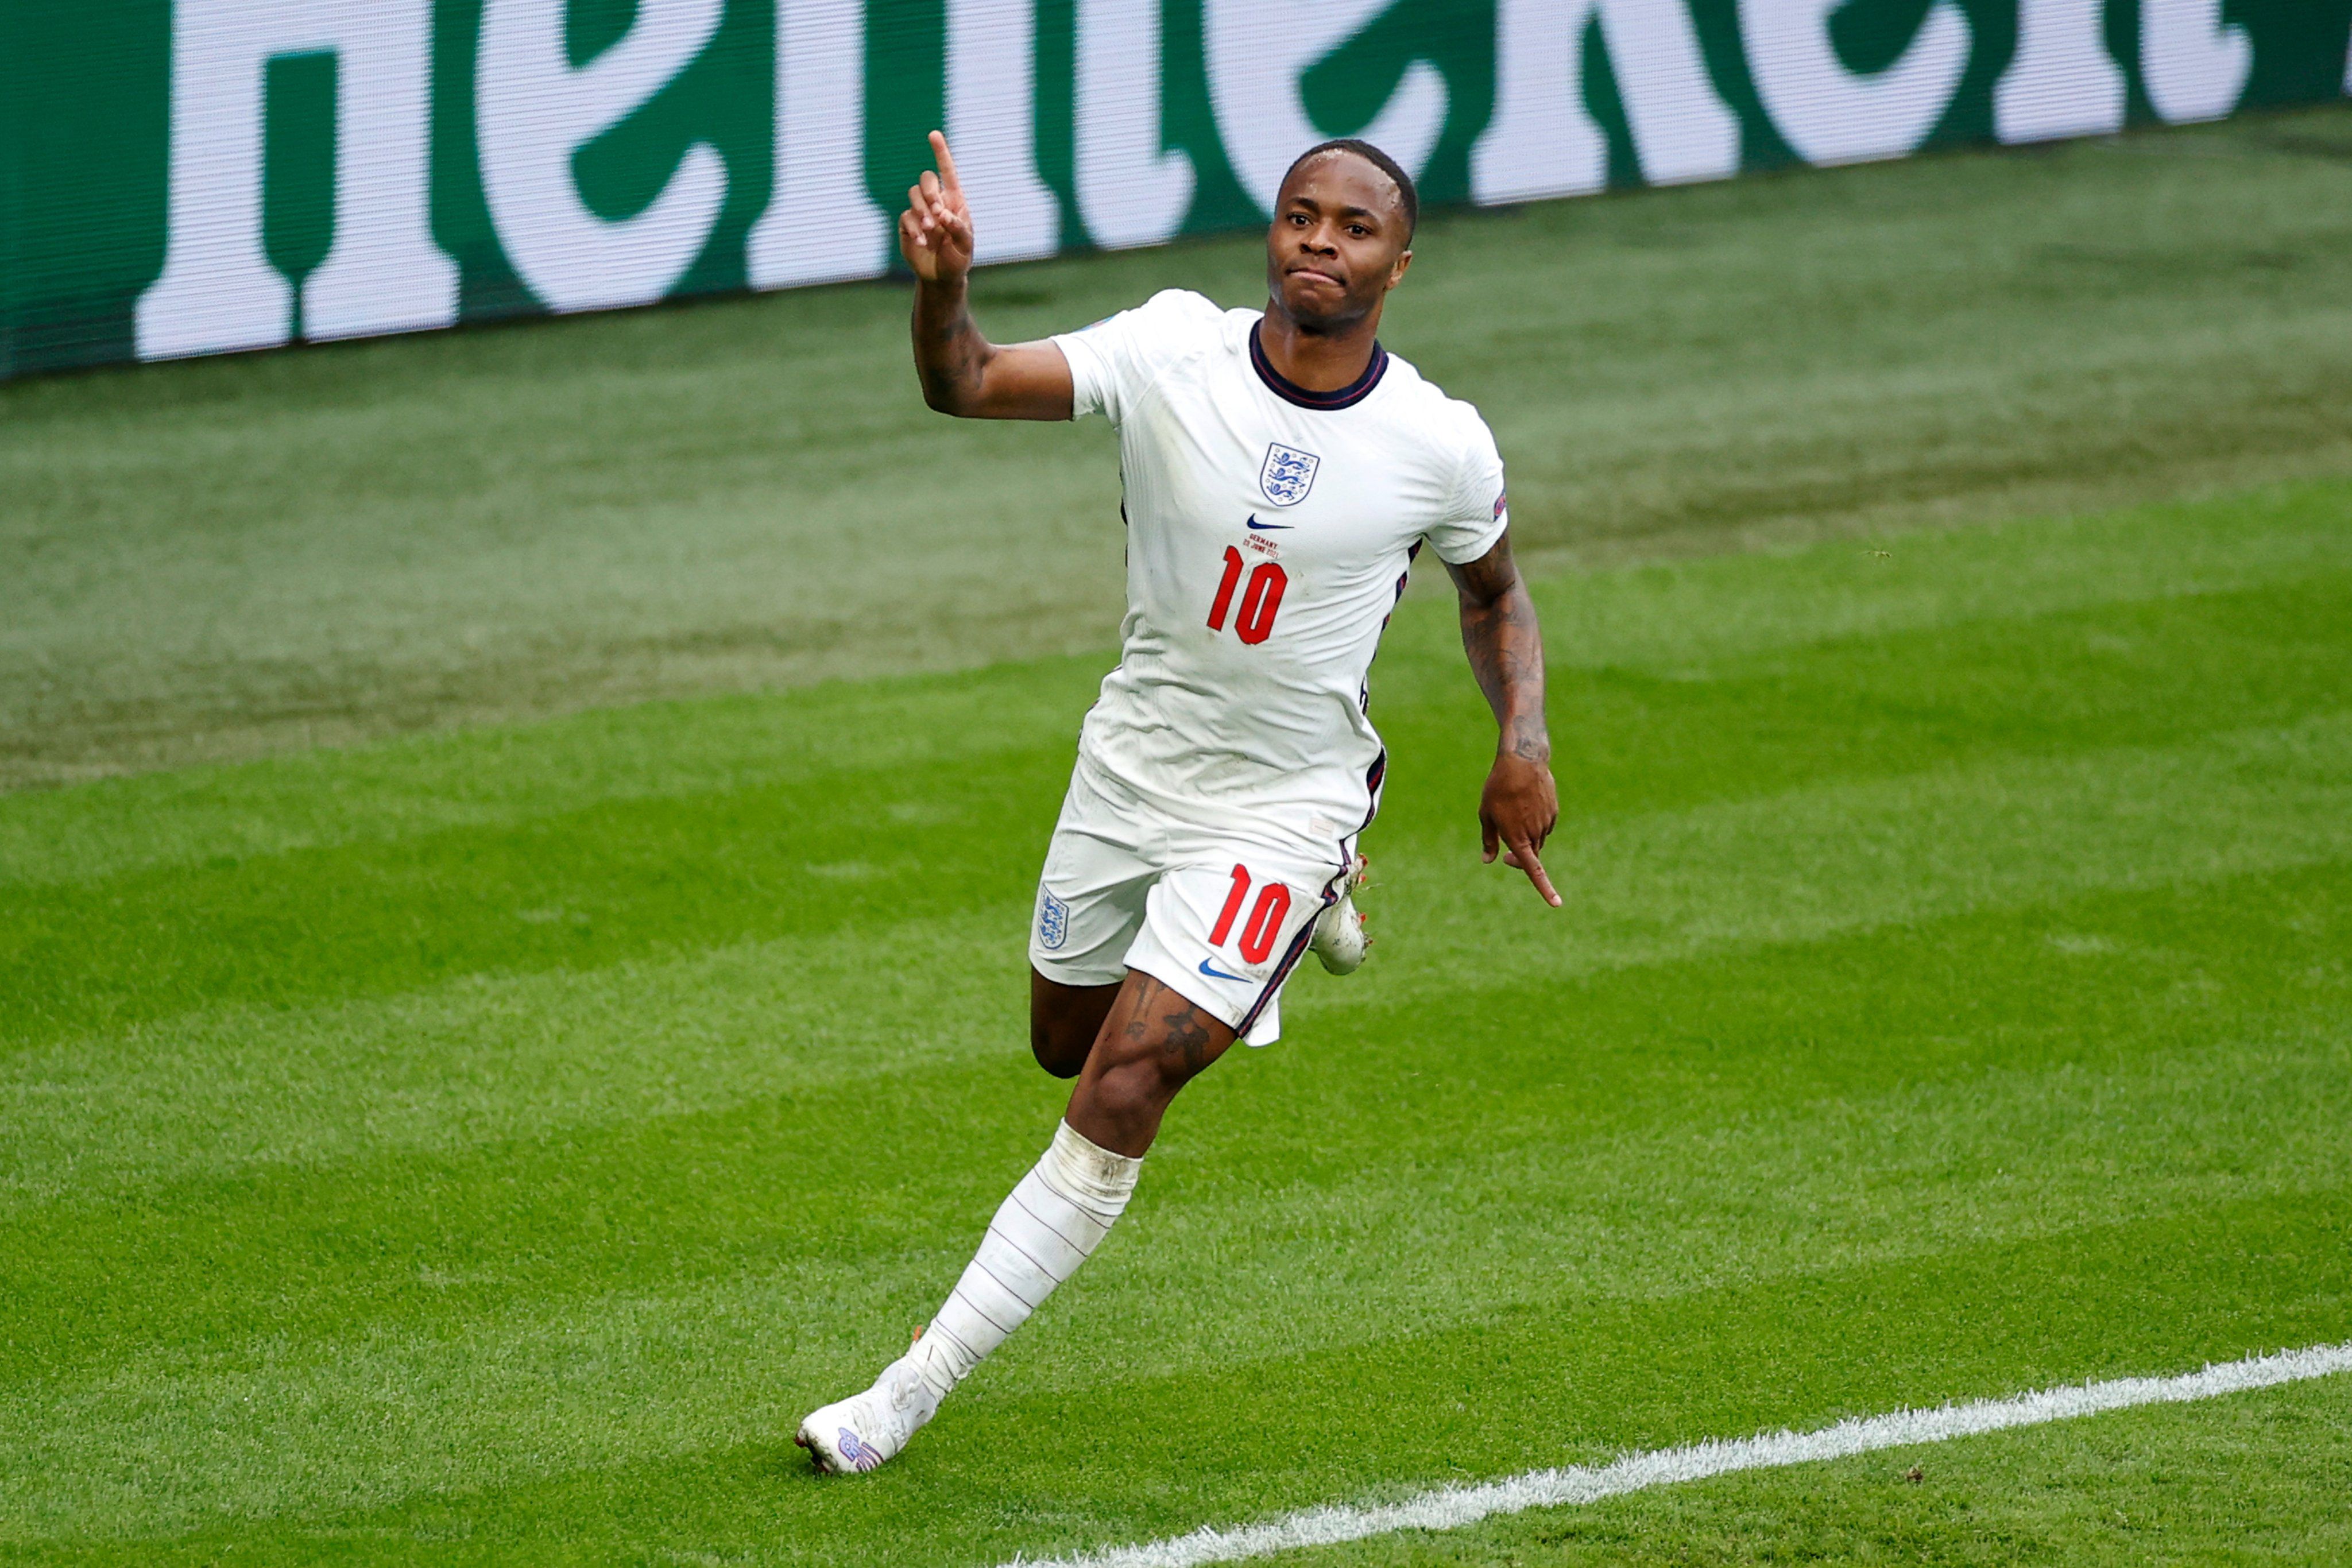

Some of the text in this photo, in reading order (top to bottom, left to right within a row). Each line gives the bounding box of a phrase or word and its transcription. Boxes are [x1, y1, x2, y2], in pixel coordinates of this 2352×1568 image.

[1250, 533, 1278, 549] GERMANY
[1251, 543, 1266, 553] JUNE
[1266, 548, 1279, 559] 2021
[1206, 545, 1288, 645] 10
[1209, 864, 1291, 963] 10
